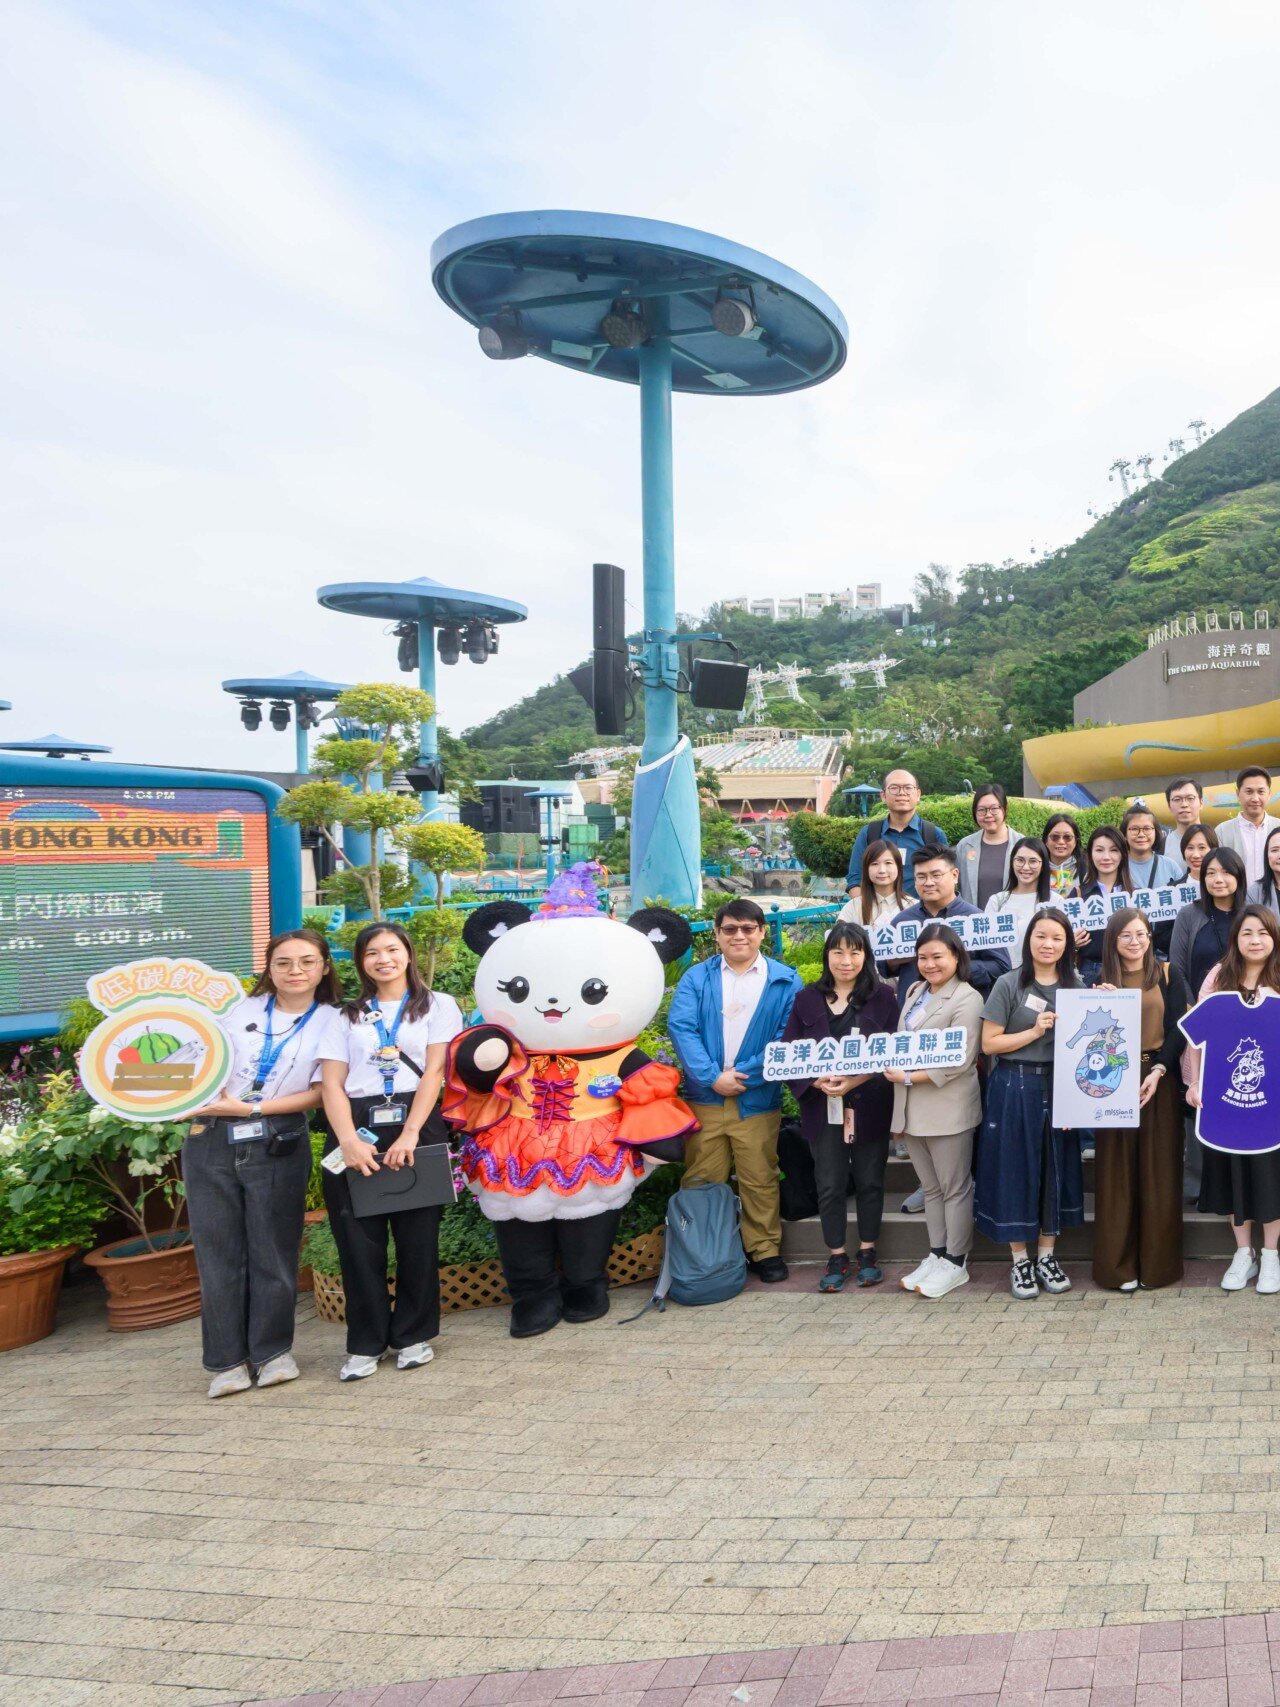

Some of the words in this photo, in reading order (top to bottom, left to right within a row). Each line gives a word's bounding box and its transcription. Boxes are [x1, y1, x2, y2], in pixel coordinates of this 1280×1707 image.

[1207, 643, 1271, 658] 海洋奇觀
[156, 791, 176, 800] PM
[107, 825, 204, 848] KONG
[1039, 887, 1198, 918] 洋公園保育聯
[1080, 917, 1104, 928] Park
[75, 929, 132, 946] 6:00
[138, 928, 193, 947] p.m.
[875, 946, 894, 956] ark
[971, 934, 1016, 946] Alliance
[99, 966, 232, 1005] 低碳飲食
[768, 1030, 963, 1064] 海洋公園保育聯盟
[767, 1065, 804, 1077] Ocean
[806, 1062, 833, 1074] Park
[835, 1057, 913, 1071] Conservation
[915, 1052, 962, 1065] Alliance
